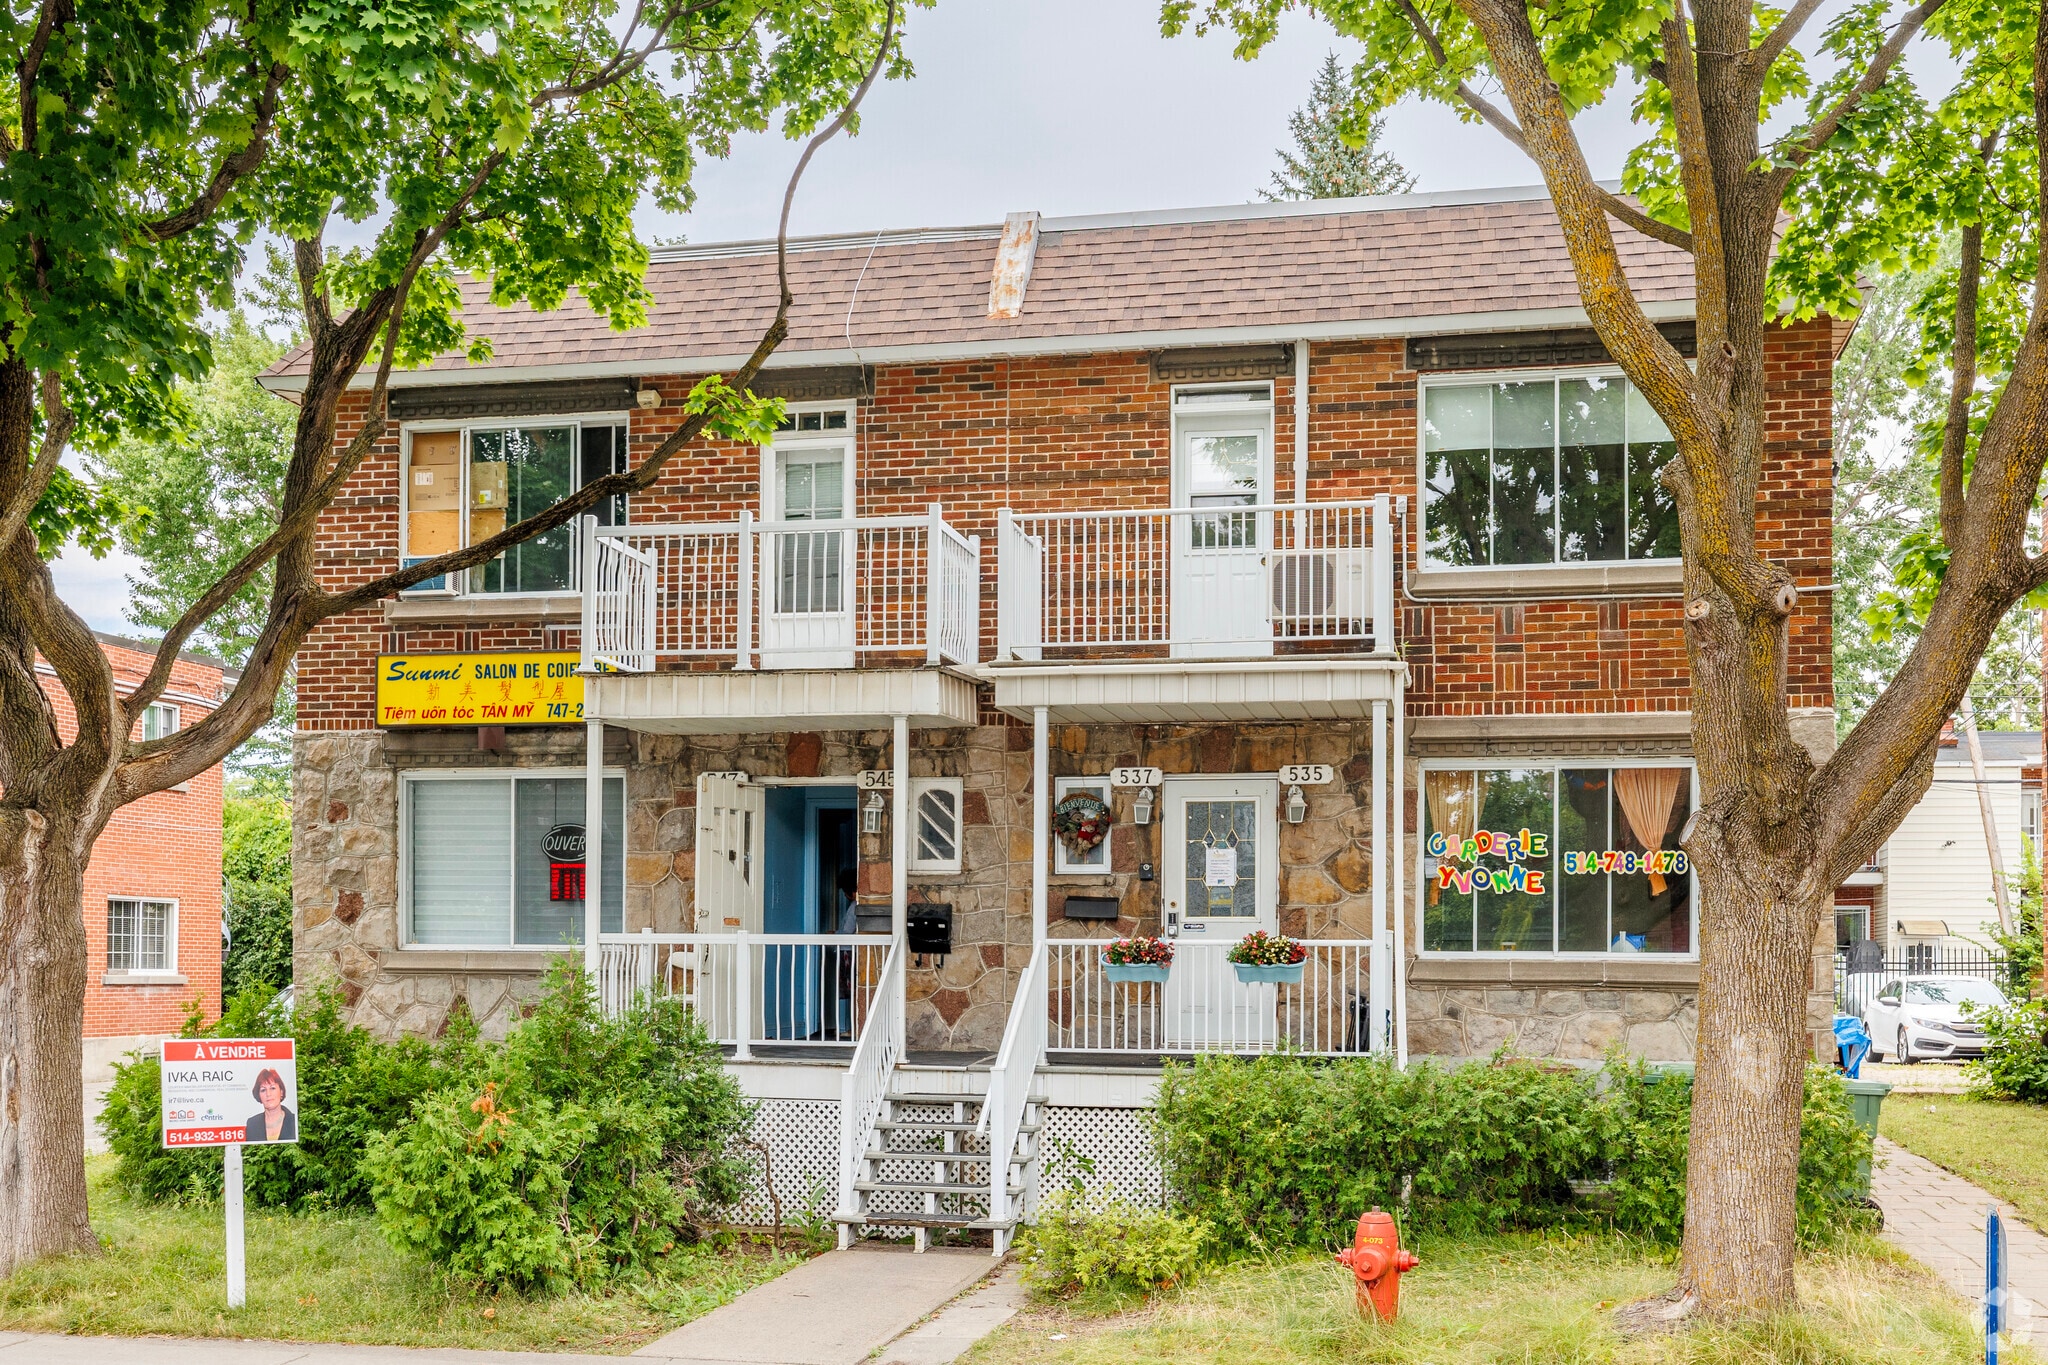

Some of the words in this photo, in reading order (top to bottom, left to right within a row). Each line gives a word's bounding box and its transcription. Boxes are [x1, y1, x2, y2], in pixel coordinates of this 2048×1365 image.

[386, 661, 463, 681] Sunmi
[475, 663, 517, 679] SALON
[524, 663, 540, 678] DE
[547, 702, 584, 718] 747-2
[865, 771, 894, 787] 545
[1120, 769, 1153, 784] 537
[1289, 766, 1323, 781] 535
[1060, 797, 1101, 814] BIENVENUE
[545, 835, 586, 851] OUVER
[1427, 828, 1549, 863] GARDERIE
[1564, 850, 1689, 874] 514-748-1478
[1438, 864, 1546, 895] YVONNE
[194, 1044, 205, 1059] À
[209, 1046, 266, 1058] VENDRE
[168, 1072, 198, 1082] IVKA
[202, 1070, 234, 1081] RAIC
[170, 1130, 244, 1142] 514-932-1816
[1362, 1237, 1384, 1245] 4-073
